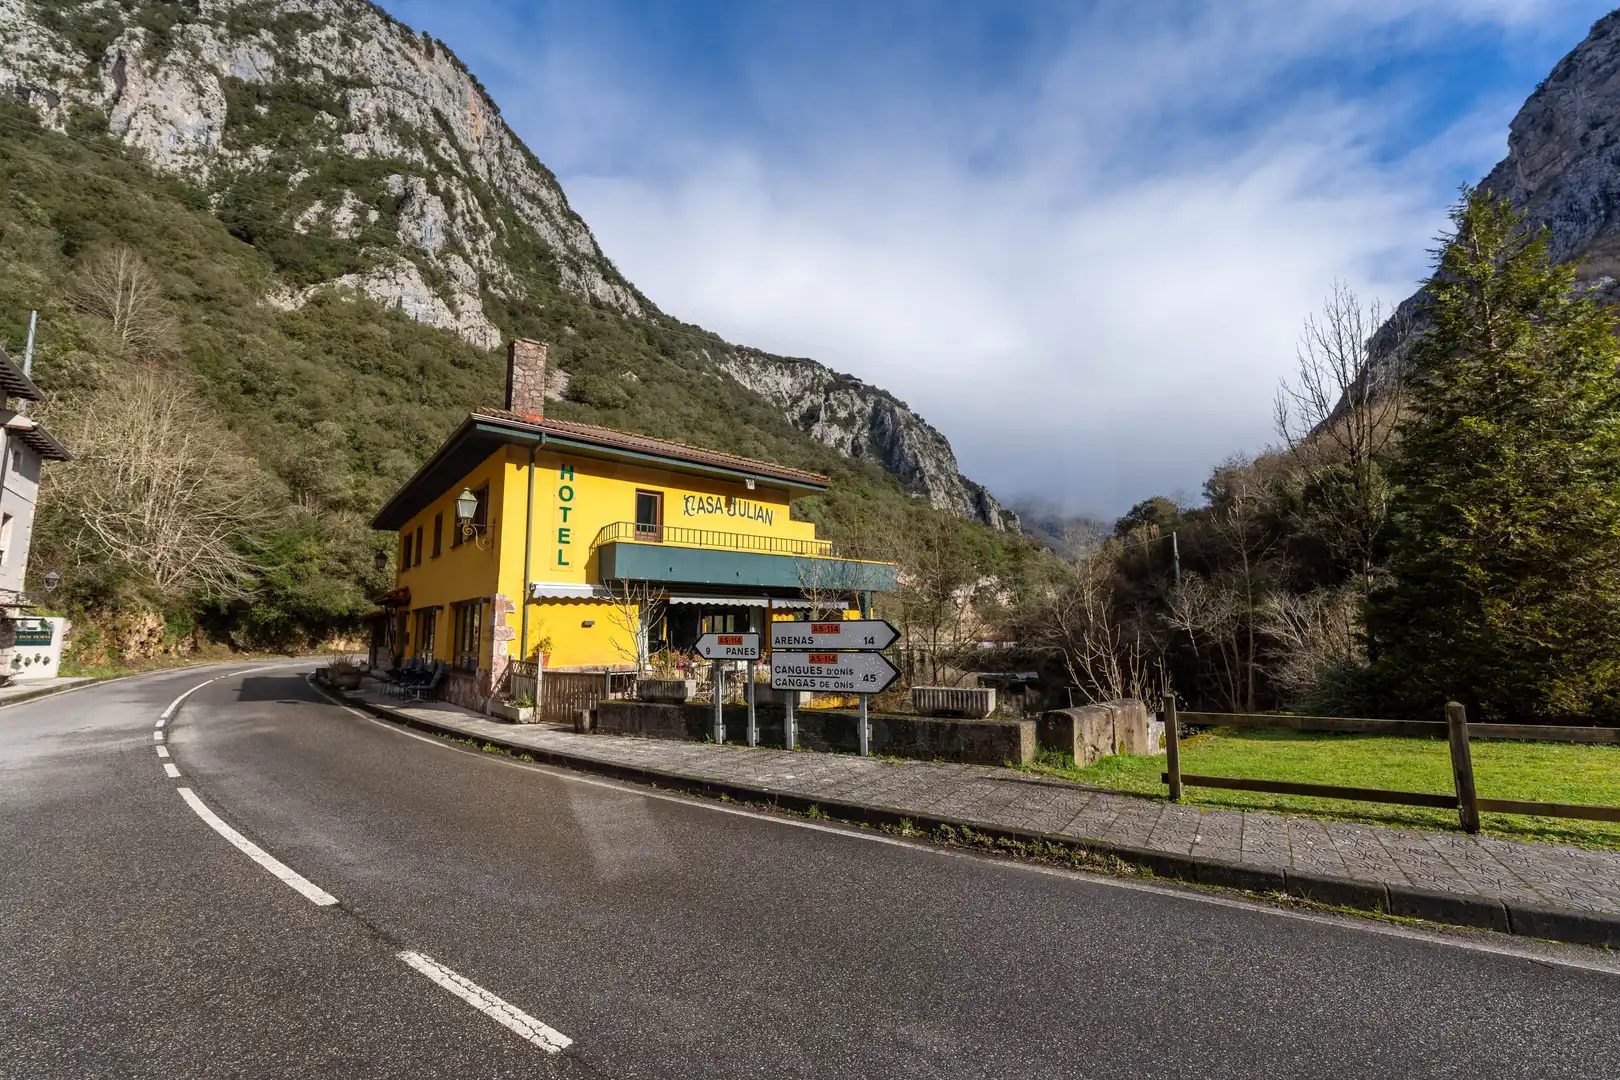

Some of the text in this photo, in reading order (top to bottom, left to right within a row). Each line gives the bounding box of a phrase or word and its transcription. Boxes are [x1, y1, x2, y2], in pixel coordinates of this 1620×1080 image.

[558, 464, 574, 566] HOTEL
[683, 495, 773, 526] CASA JULIAN
[813, 625, 839, 633] AS-114
[774, 636, 875, 645] ARENAS 14
[705, 647, 756, 656] 9 PANES
[810, 655, 836, 663] AS-114
[774, 665, 823, 675] CANGUES
[774, 678, 816, 688] CANGAS
[862, 674, 876, 683] 45
